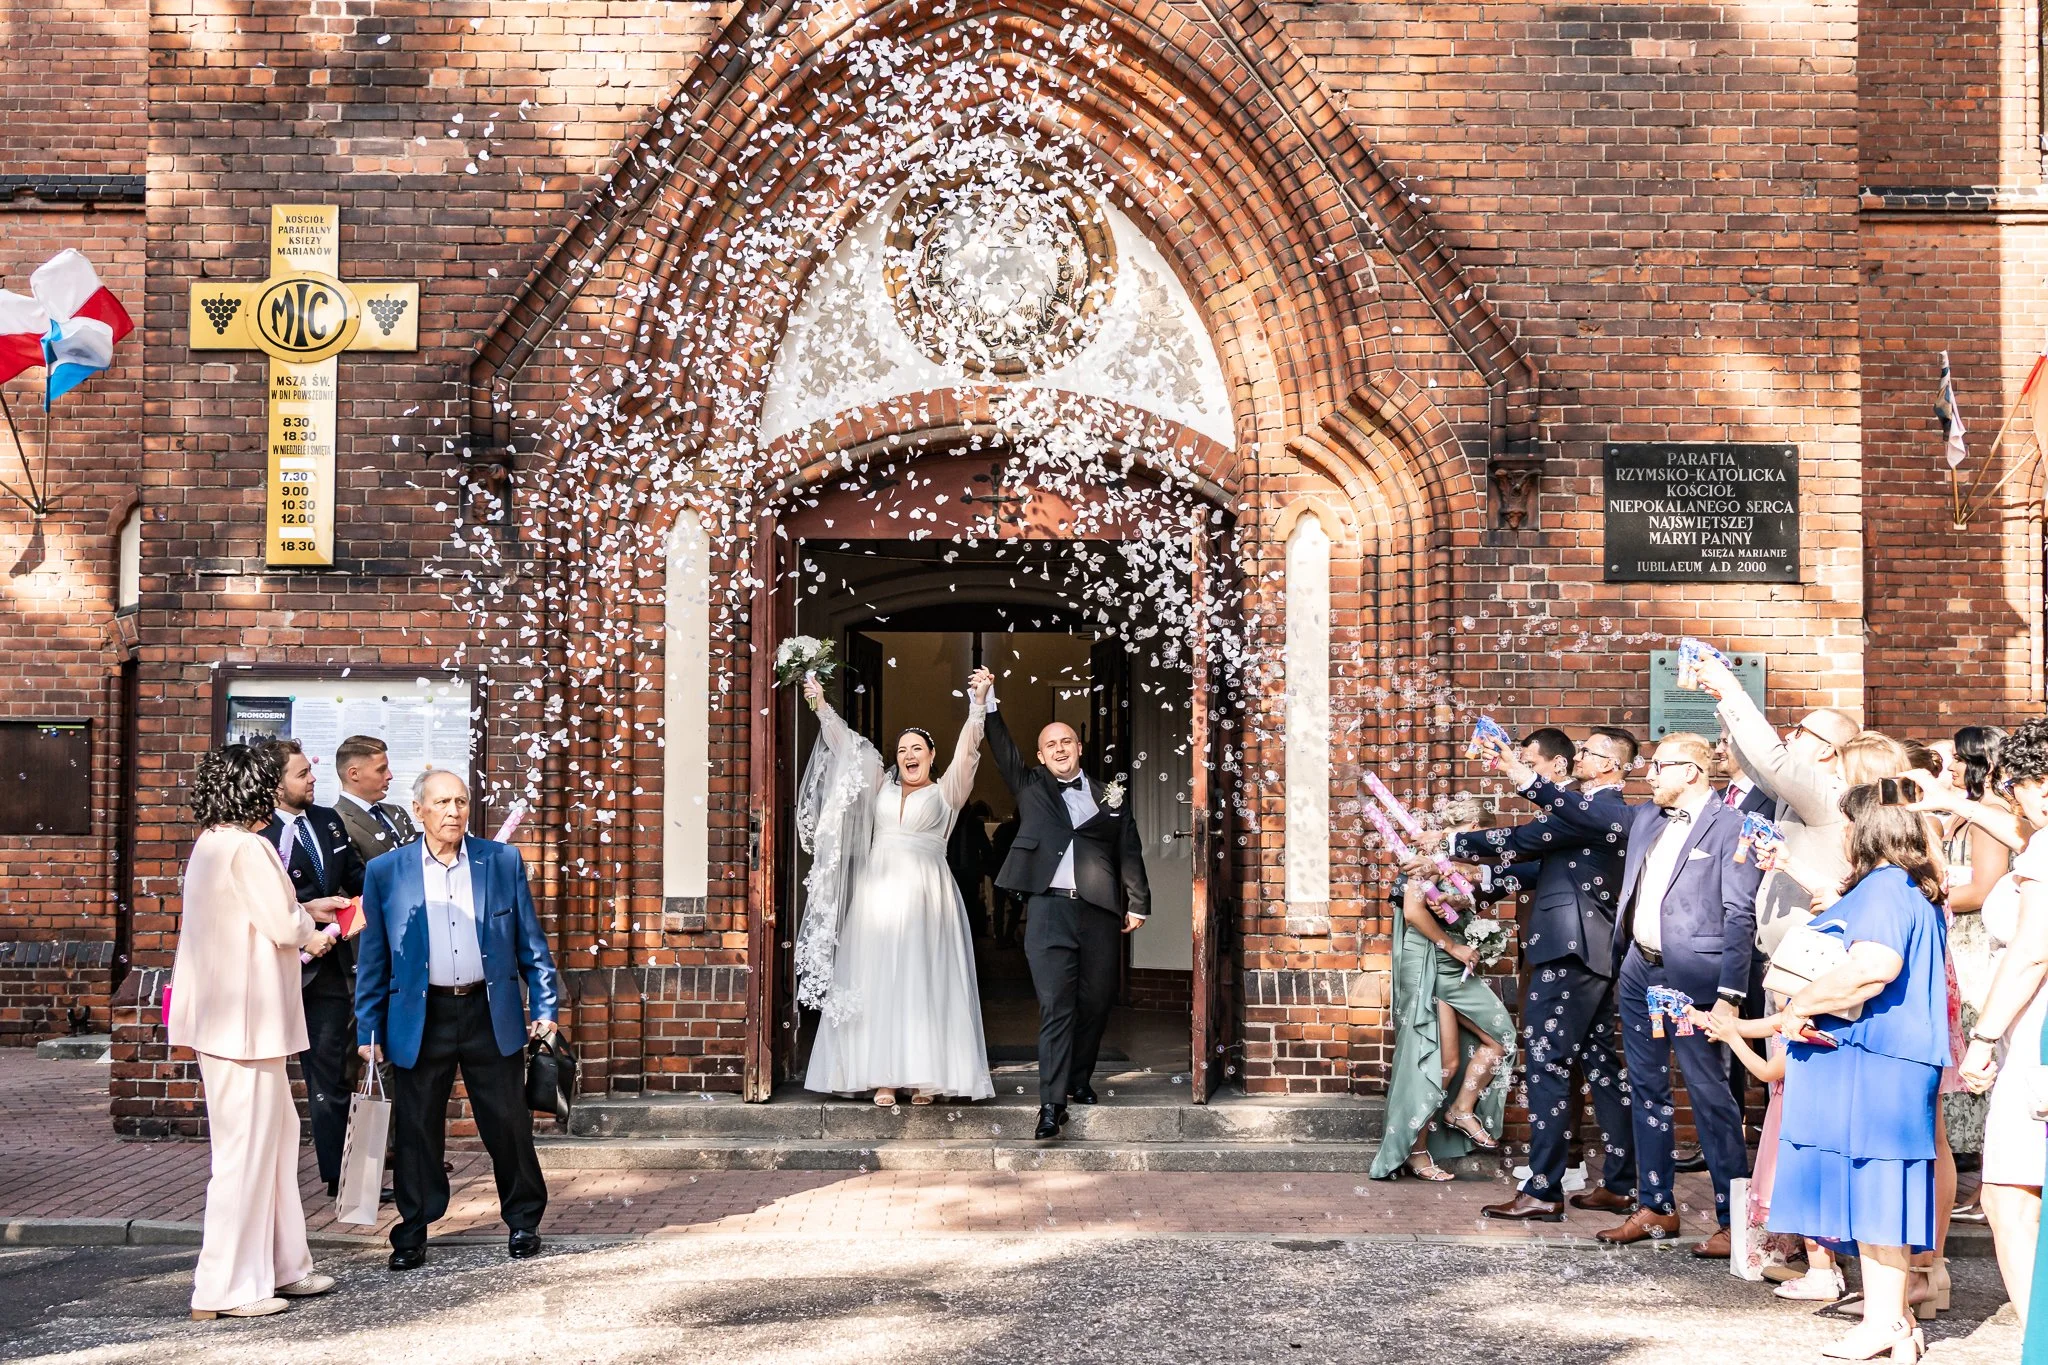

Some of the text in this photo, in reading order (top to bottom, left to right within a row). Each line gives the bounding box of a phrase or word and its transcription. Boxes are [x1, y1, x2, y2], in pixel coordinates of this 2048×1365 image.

[286, 213, 325, 224] KOŚCIÓŁ
[278, 226, 332, 235] PARAFIALNY
[277, 246, 332, 256] MARIANÓW
[272, 284, 329, 347] MIC
[276, 373, 331, 387] MSZA ŚW.
[271, 389, 278, 400] W
[279, 389, 291, 400] DNI
[283, 417, 310, 428] 8.30
[283, 431, 317, 442] 18.30
[272, 444, 279, 455] W
[1667, 452, 1736, 466] PARAFIA
[281, 472, 308, 481] 7.30
[1615, 468, 1787, 482] RZYMSKO-KATOLICKA
[281, 486, 309, 496] 9.00
[1666, 481, 1736, 498] KOŚCIÓŁ
[281, 500, 316, 510] 10.30
[1610, 500, 1795, 514] NIEPOKALANEGO SERCA
[281, 514, 316, 524] 12.00
[1648, 513, 1754, 531] NAJŚWIĘTSZEJ
[1649, 531, 1753, 545] MARYI PANNY
[281, 541, 316, 551] 18.30
[1701, 548, 1788, 559] KSIĘŻA MARIANIE
[1637, 561, 1767, 573] IUBILAEUM A.D. 2000
[236, 711, 286, 720] PROMODERN
